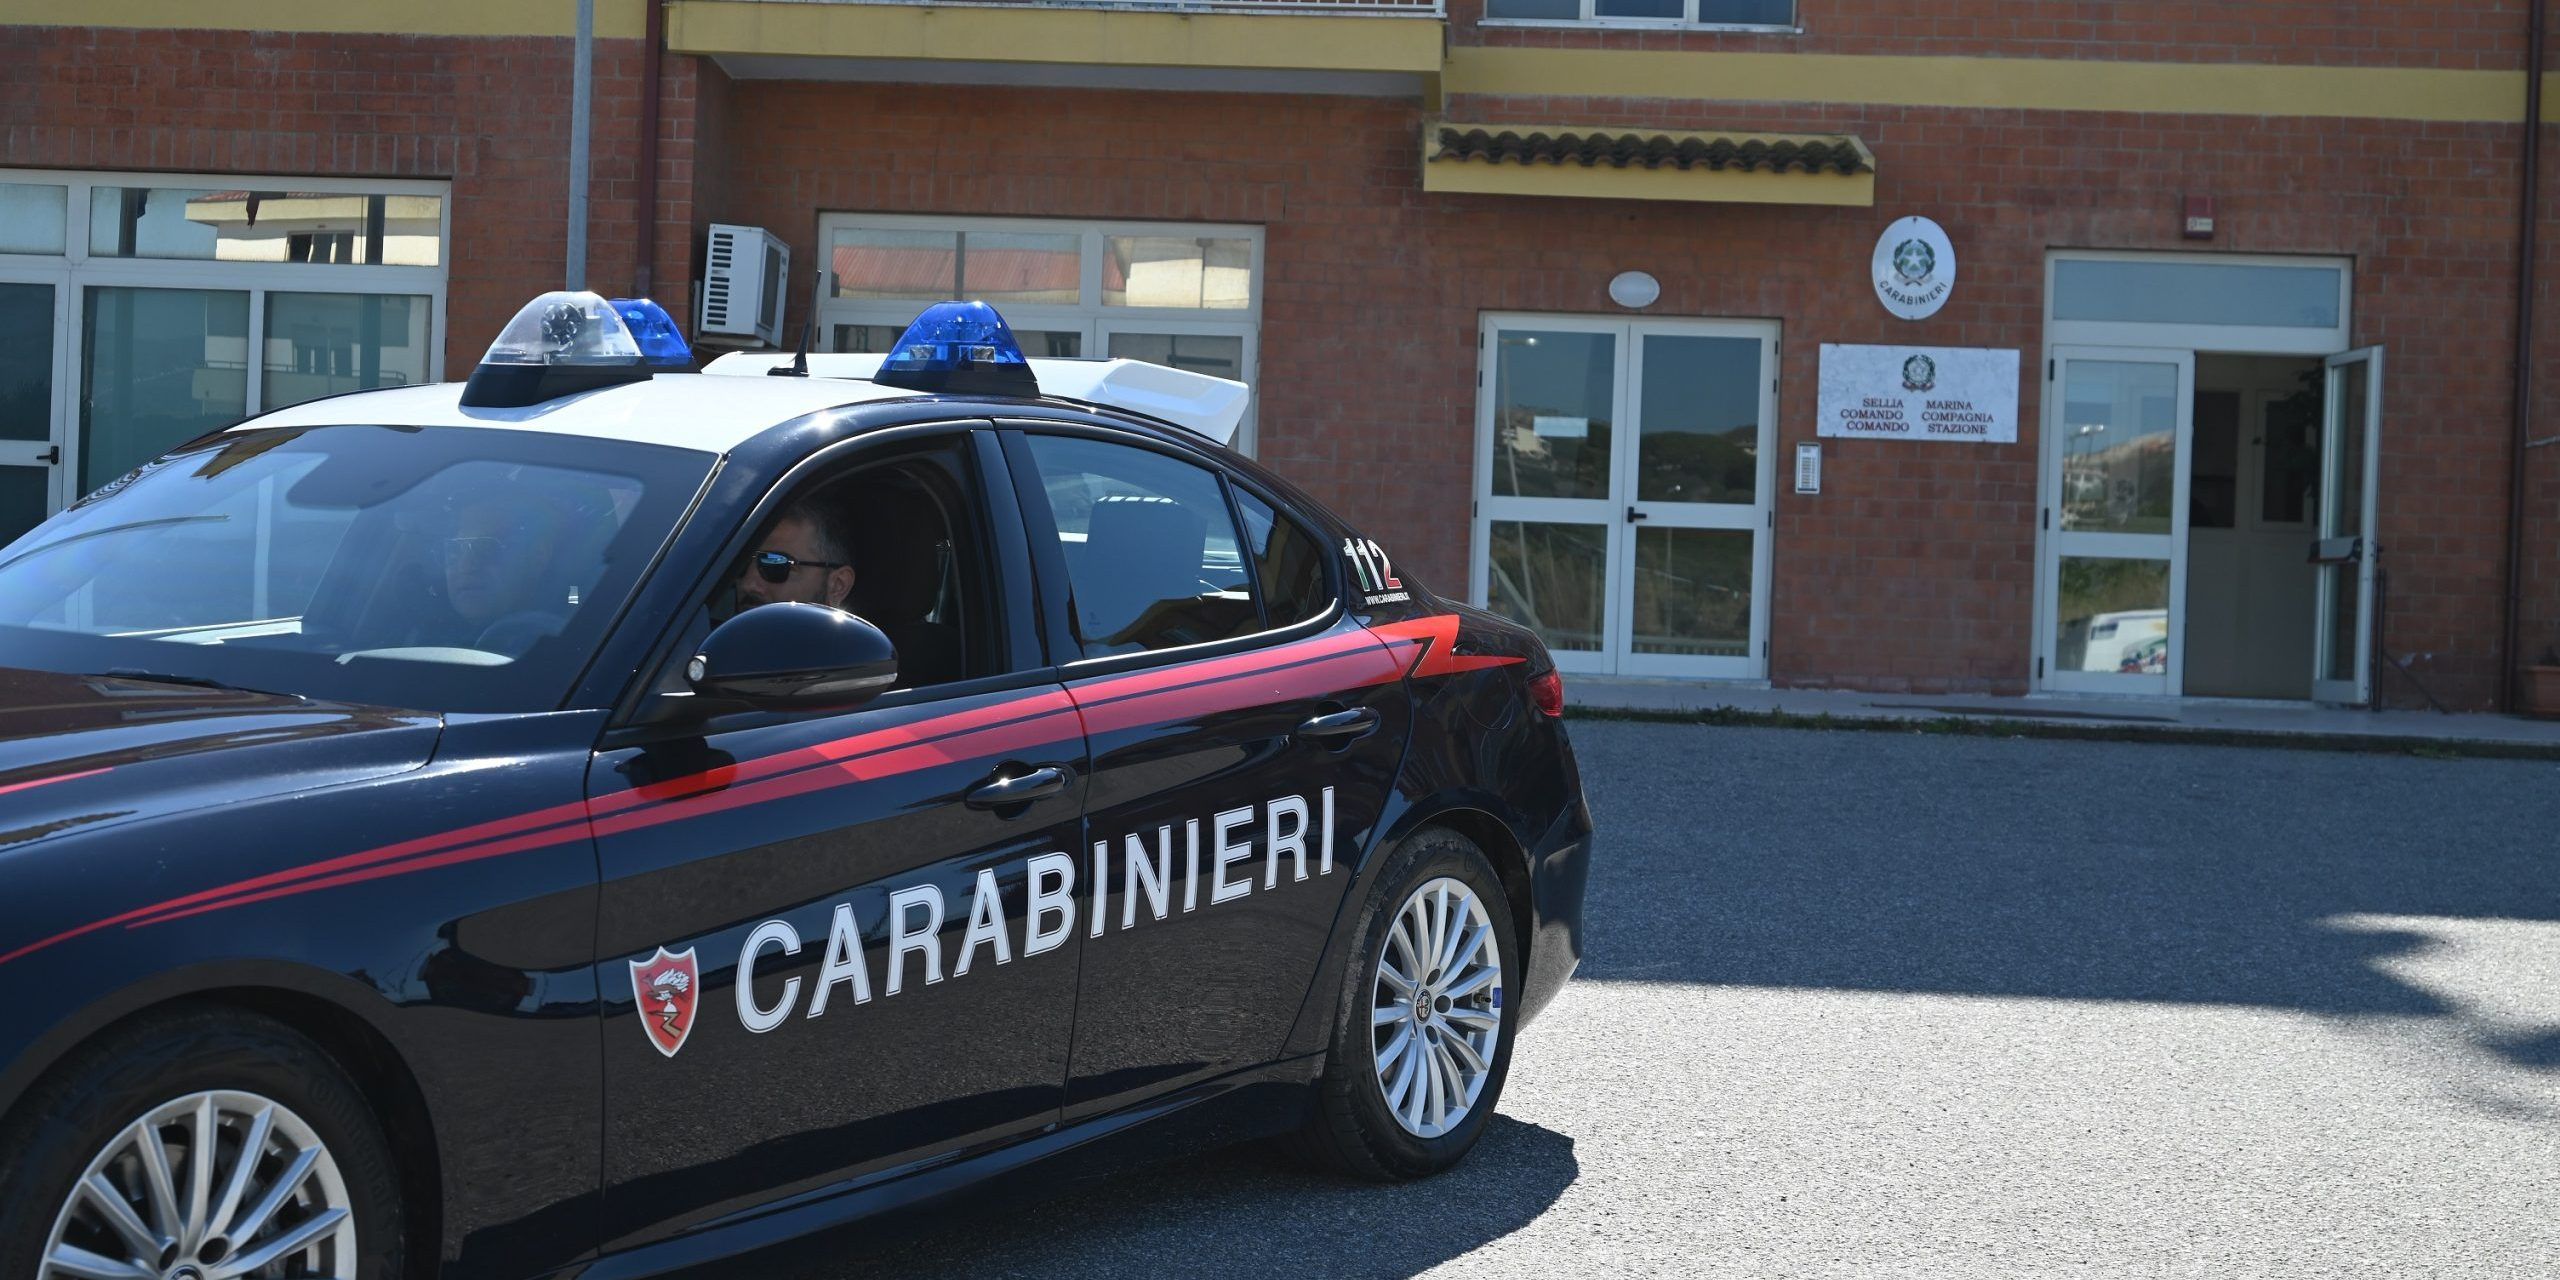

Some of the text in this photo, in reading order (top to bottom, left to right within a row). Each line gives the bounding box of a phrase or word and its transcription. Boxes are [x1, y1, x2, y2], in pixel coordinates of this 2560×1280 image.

[1879, 280, 1948, 305] CARABINIERI
[1862, 398, 1973, 411] SELLIA MARINA
[1840, 409, 1994, 423] COMANDO COMPAGNIA
[1846, 420, 1988, 434] COMANDO STAZIONE
[1343, 538, 1402, 592] 112
[736, 786, 1334, 1034] CARABINIERI
